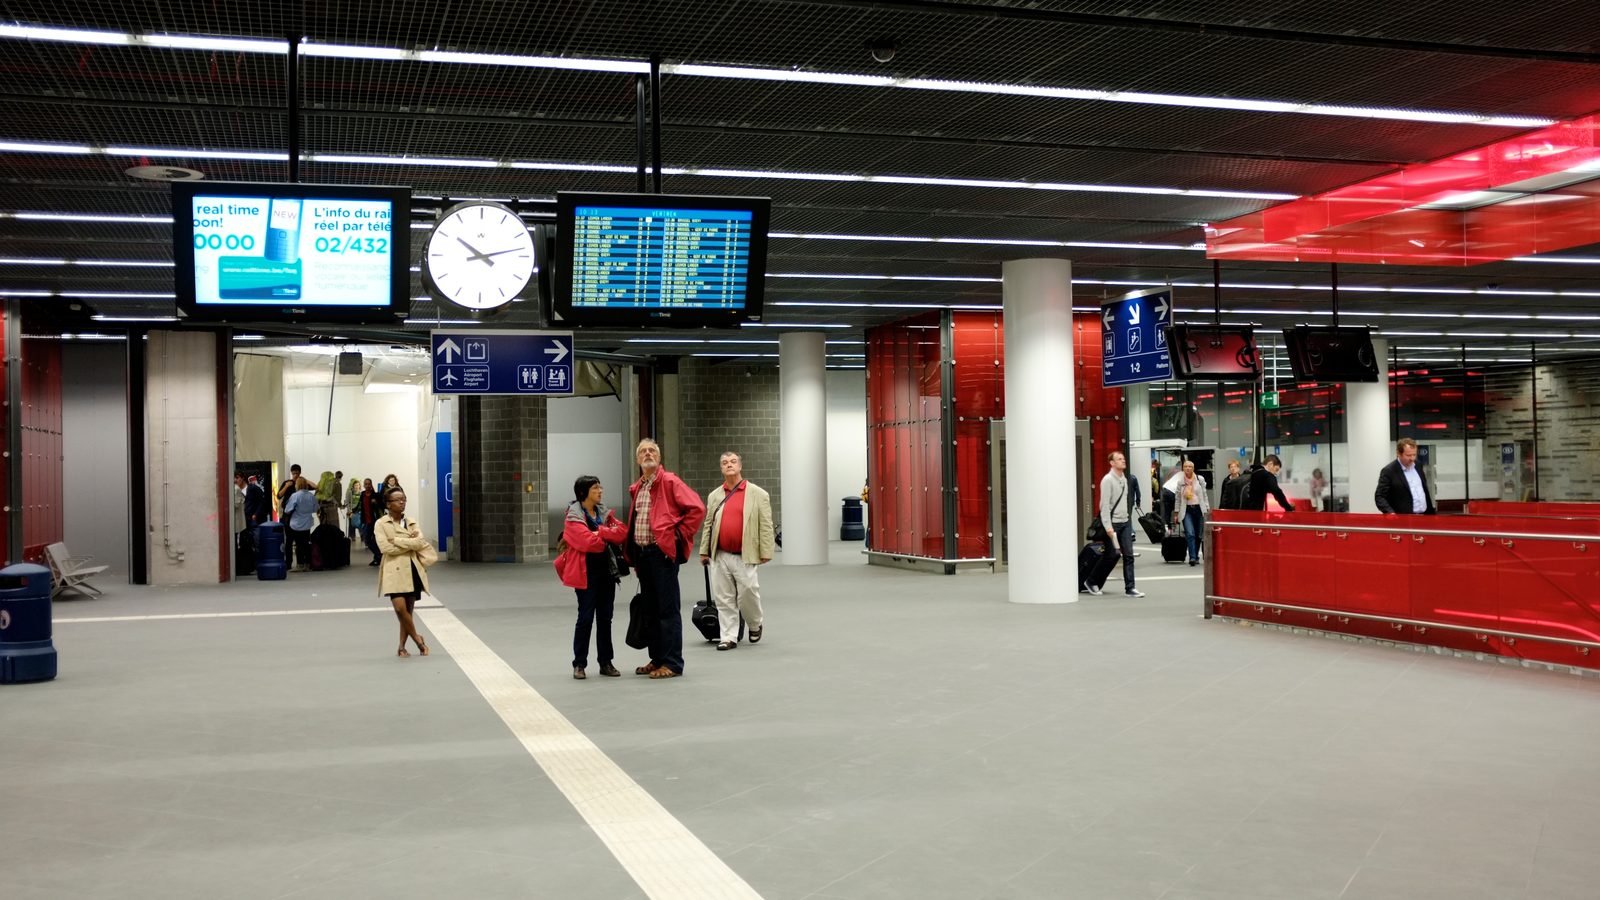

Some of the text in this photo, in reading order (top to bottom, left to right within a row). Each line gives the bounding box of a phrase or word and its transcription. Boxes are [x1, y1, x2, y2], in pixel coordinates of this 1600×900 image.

[197, 204, 260, 215] real time
[273, 210, 297, 220] NEW
[314, 207, 351, 218] L'info
[354, 208, 371, 219] du
[314, 220, 339, 231] réel
[343, 222, 364, 232] par
[315, 236, 388, 256] 02/432
[1130, 362, 1141, 374] 1-2
